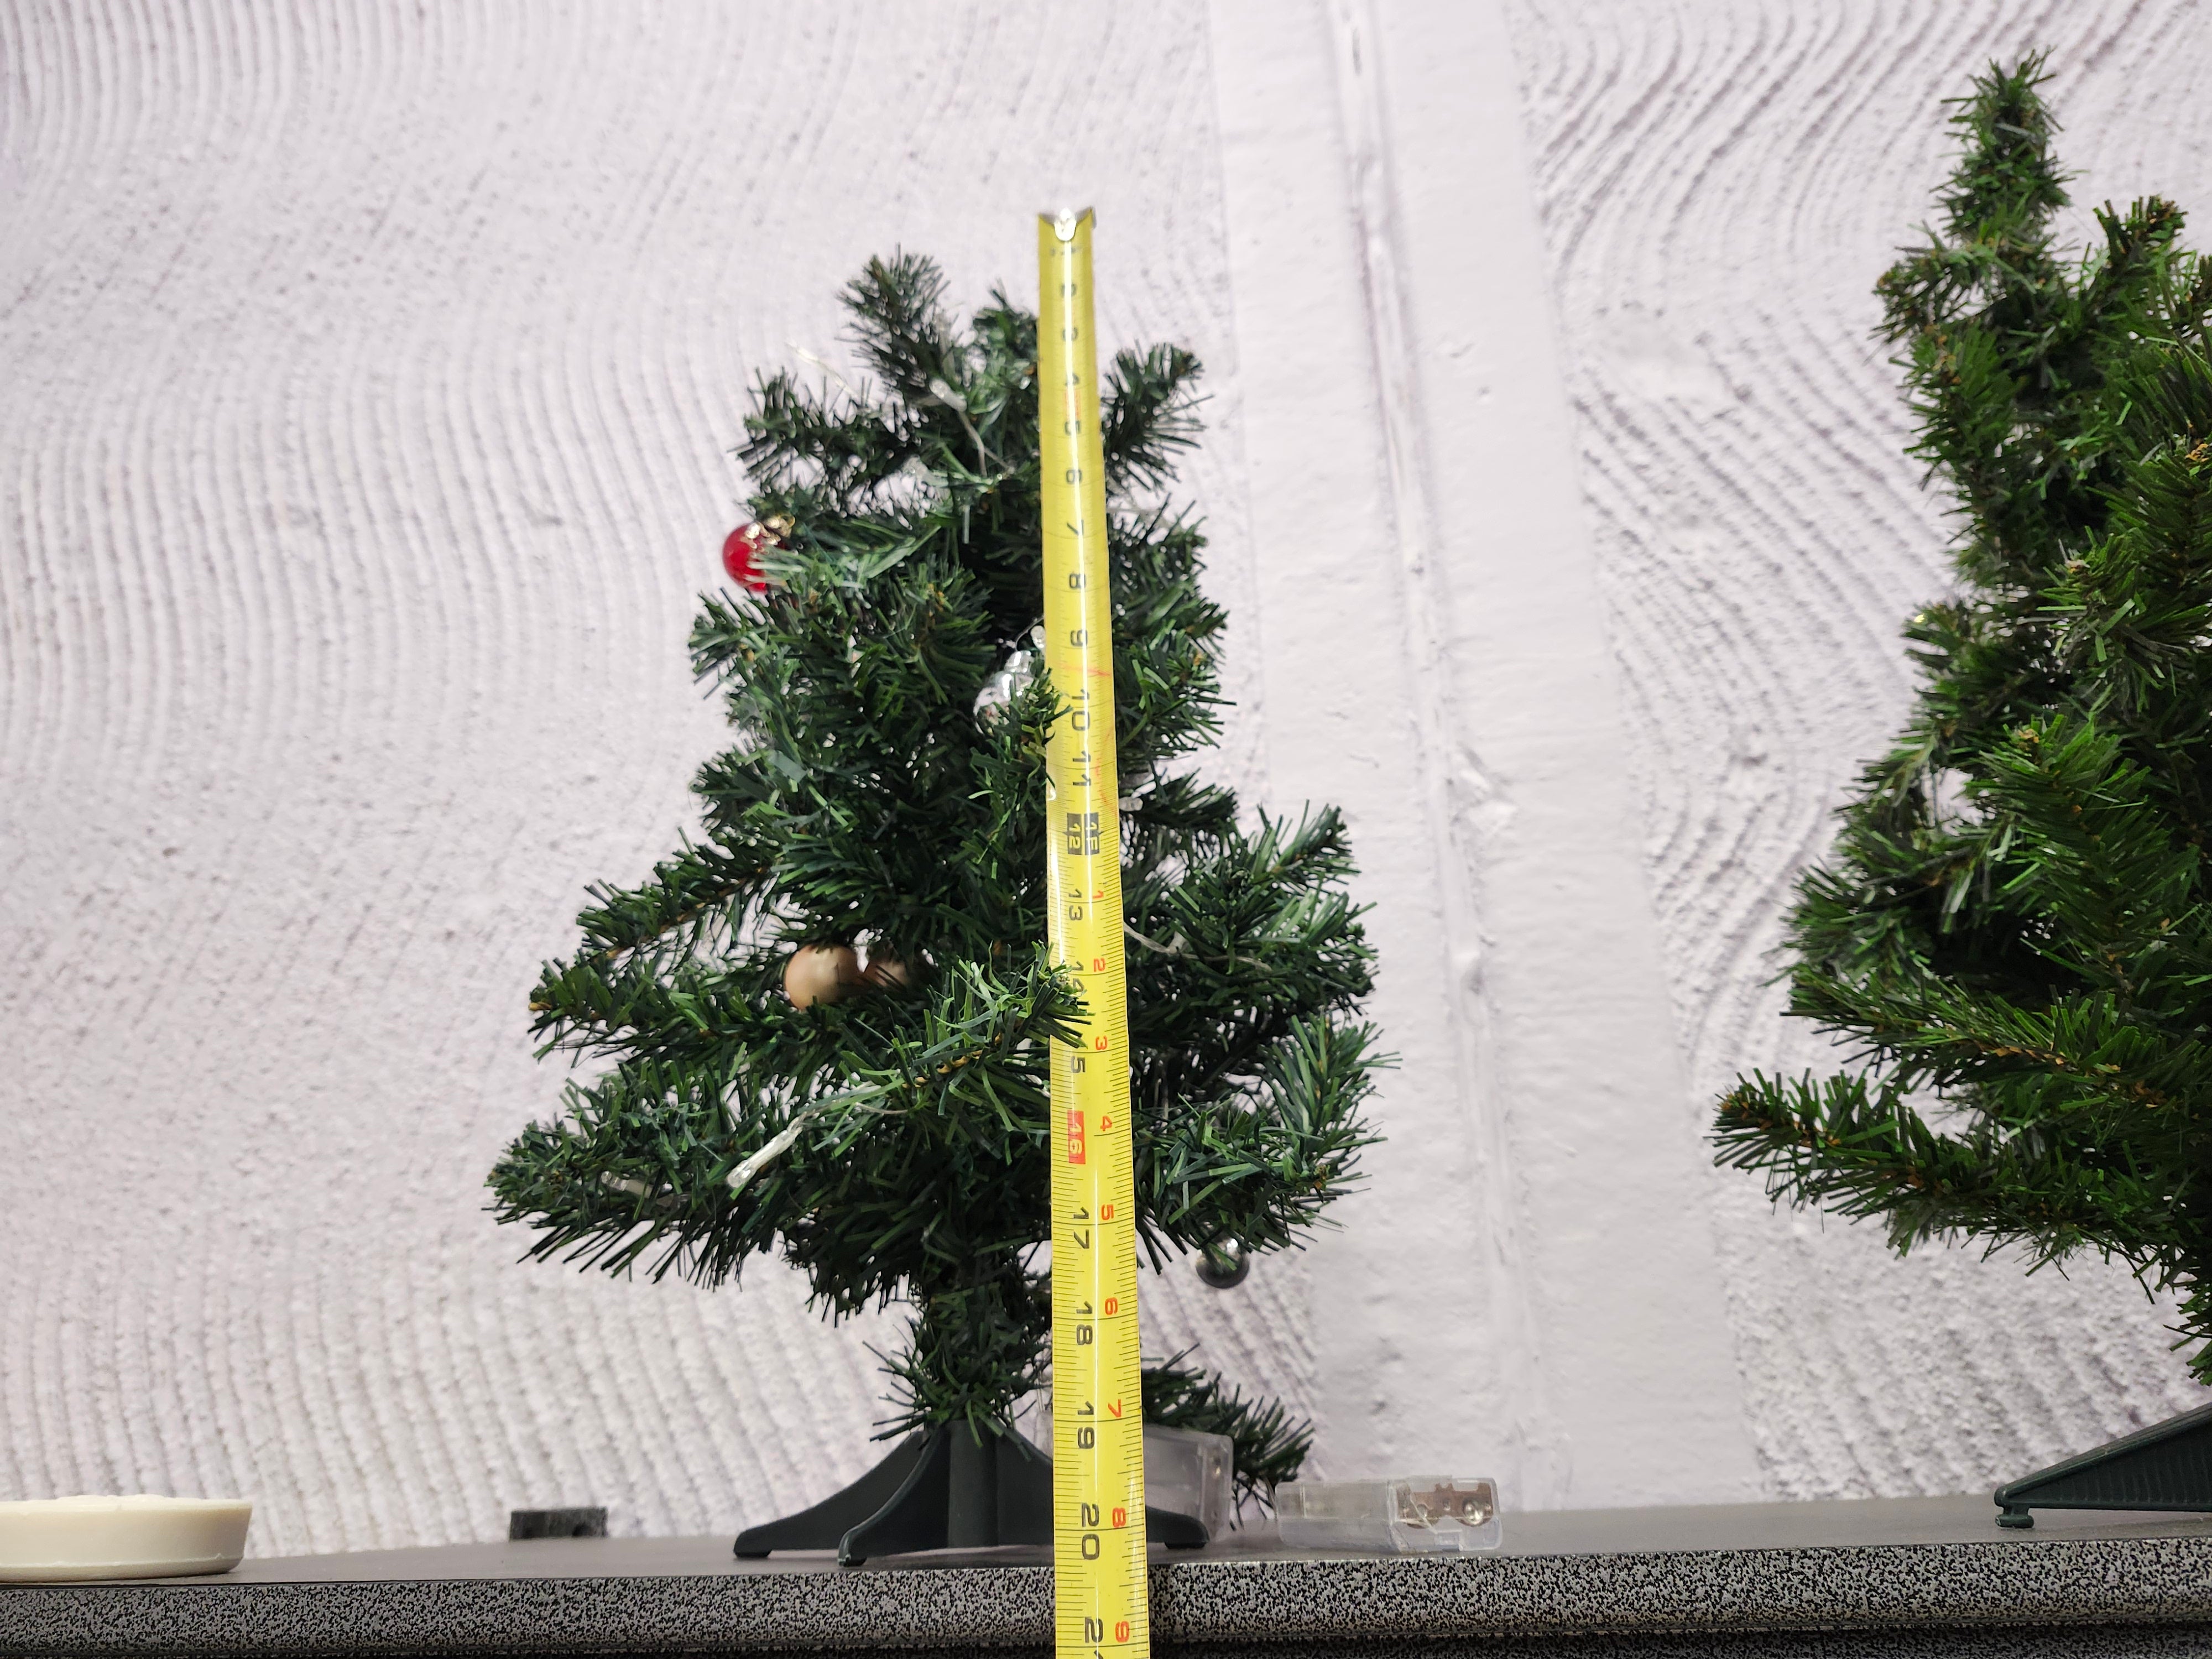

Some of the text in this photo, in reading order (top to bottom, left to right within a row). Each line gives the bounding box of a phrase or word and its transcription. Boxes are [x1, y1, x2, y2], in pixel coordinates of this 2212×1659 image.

[1066, 469, 1082, 484] 6
[1067, 519, 1083, 535] 7
[1070, 573, 1086, 589] 8
[1070, 629, 1088, 647] 9
[1071, 689, 1090, 731] 10
[1072, 750, 1091, 786] 11
[1068, 823, 1081, 849] 12
[1093, 890, 1104, 899] 1
[1069, 889, 1083, 921] 13
[1093, 958, 1106, 972] 2
[1095, 1036, 1108, 1051] 3
[1100, 1115, 1113, 1131] 4
[1070, 1123, 1083, 1155] 16
[1101, 1204, 1114, 1220] 5
[1073, 1207, 1089, 1249] 17
[1104, 1297, 1118, 1315] 6
[1076, 1301, 1093, 1345] 18
[1108, 1399, 1121, 1418] 7
[1077, 1401, 1095, 1449] 19
[1112, 1507, 1126, 1528] 8
[1081, 1502, 1100, 1561] 20
[1115, 1621, 1129, 1644] 9
